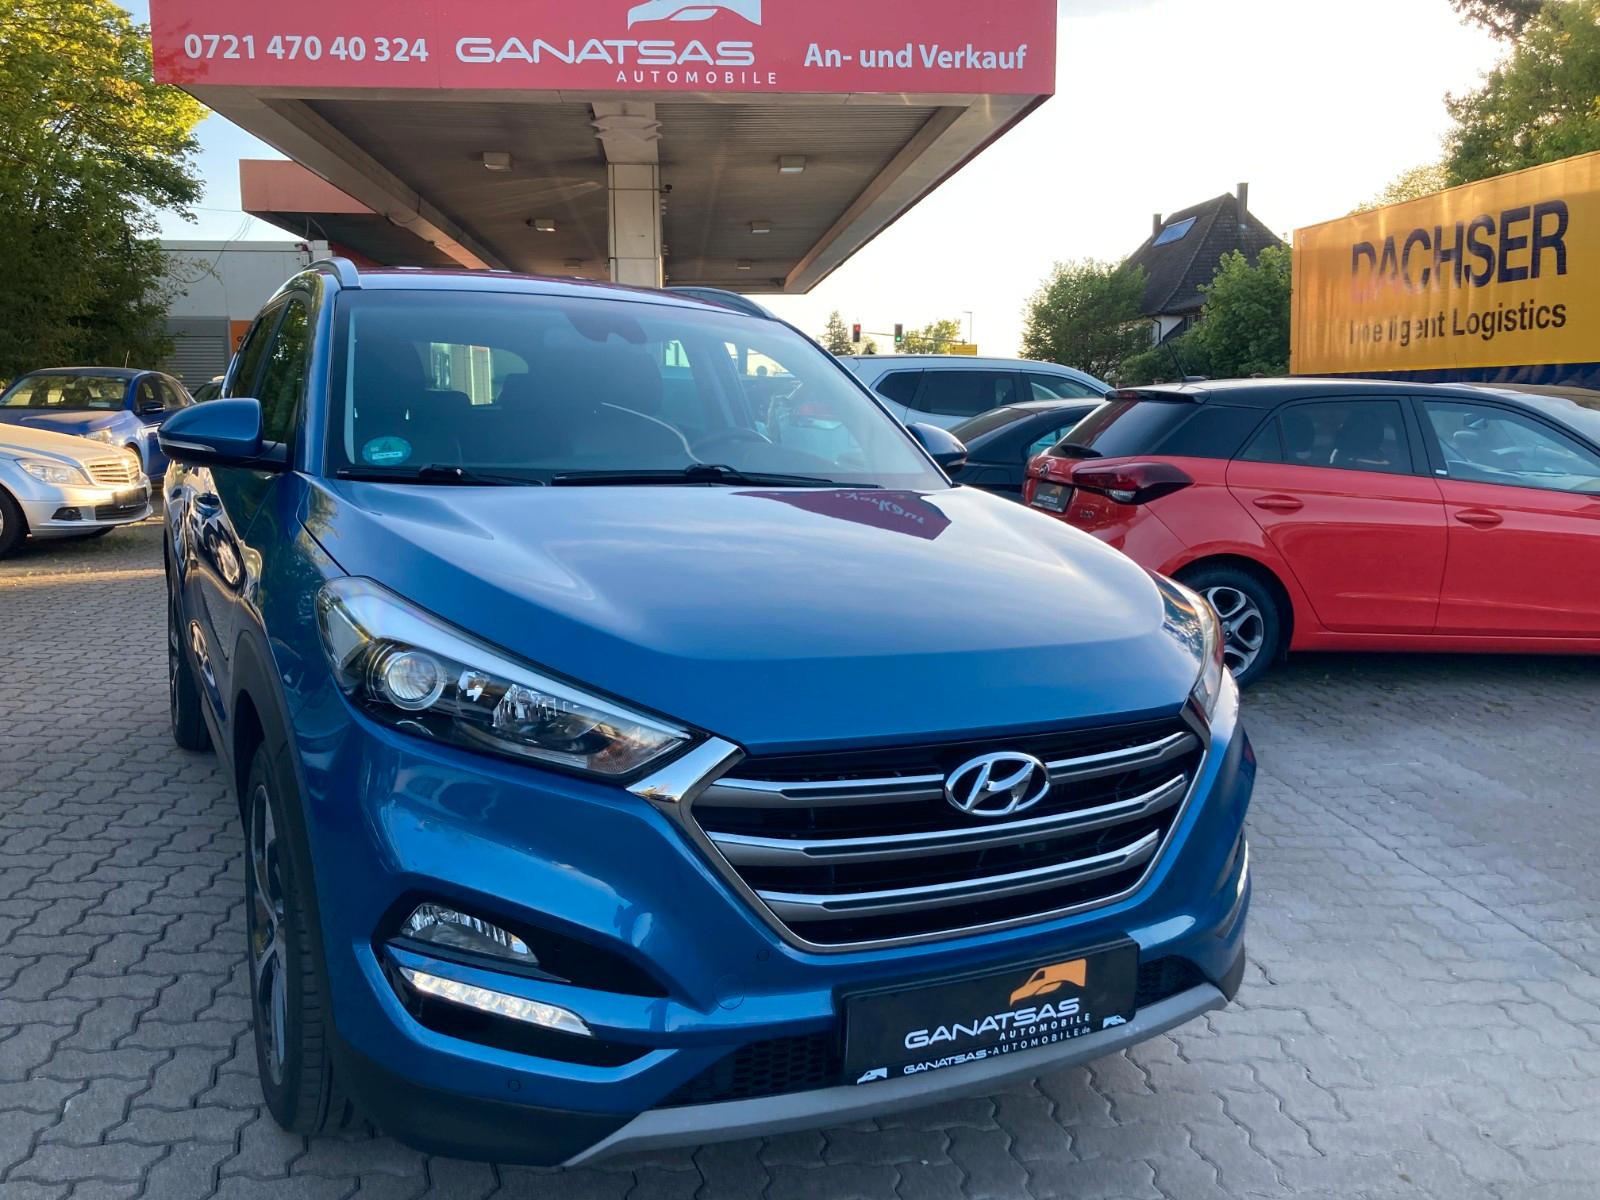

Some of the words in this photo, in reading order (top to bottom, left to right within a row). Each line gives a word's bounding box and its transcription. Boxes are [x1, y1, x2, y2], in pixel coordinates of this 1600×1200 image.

[184, 34, 255, 59] 0721
[266, 35, 322, 60] 470
[329, 36, 366, 61] 40
[374, 37, 429, 62] 324
[455, 37, 755, 66] GANATSAS
[804, 43, 852, 67] An-
[860, 44, 912, 69] und
[918, 44, 1027, 70] Verkauf
[616, 70, 777, 85] AUTOMOBILE
[1453, 299, 1567, 341] Logistics
[905, 997, 1080, 1049] GANATSAS
[999, 1013, 1091, 1041] AUTOMOBILE
